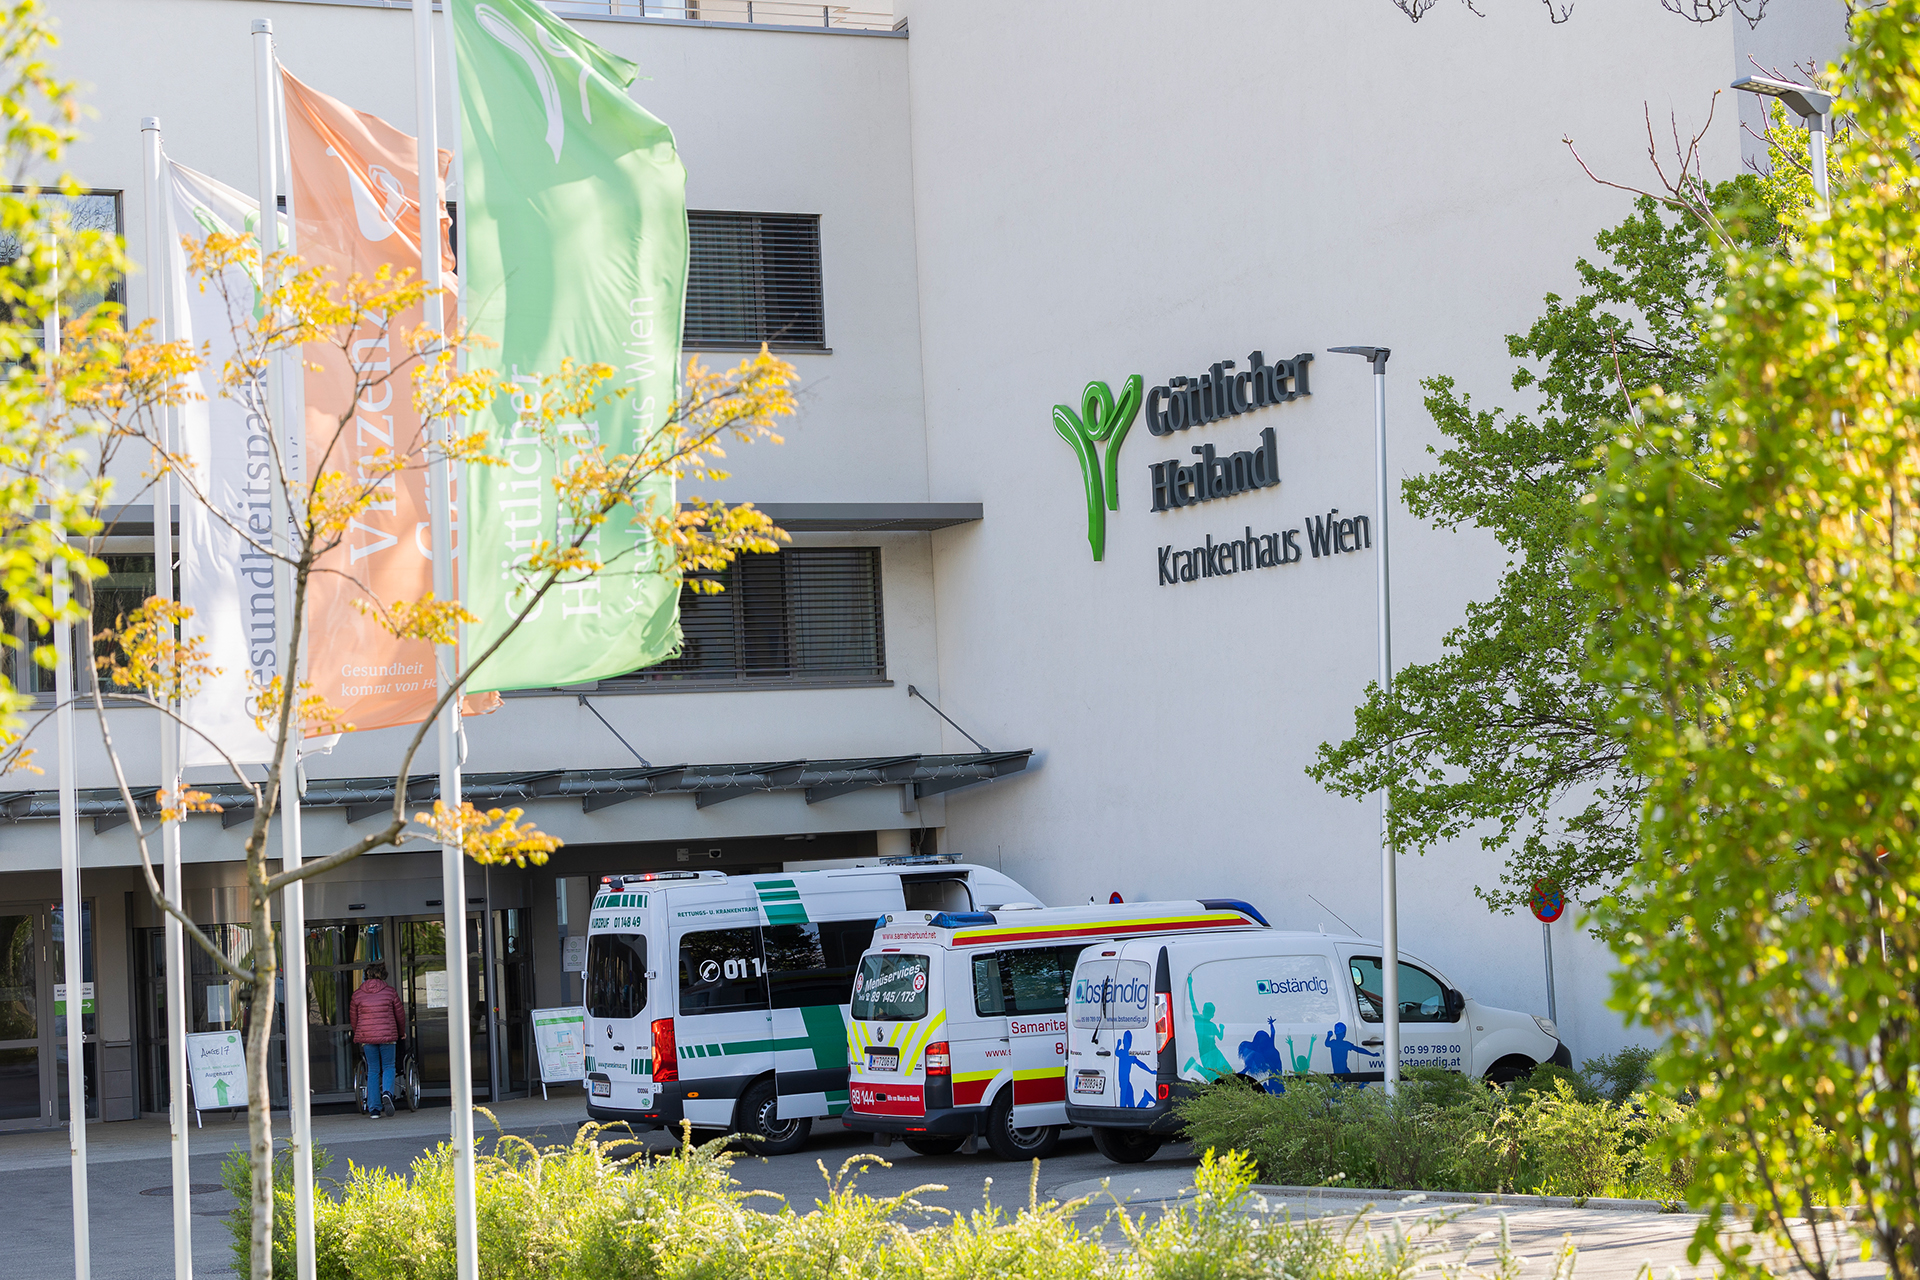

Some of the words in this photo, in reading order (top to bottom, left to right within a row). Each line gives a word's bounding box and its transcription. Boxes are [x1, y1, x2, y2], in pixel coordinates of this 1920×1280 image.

[622, 295, 655, 384] Wien
[1145, 350, 1315, 437] Göttlicher
[1148, 426, 1282, 513] Heiland
[498, 363, 544, 623] Göttlicher
[1158, 525, 1302, 586] Krankenhaus
[1305, 508, 1372, 558] Wien
[341, 661, 424, 677] Gesundheit
[341, 682, 392, 696] kommt
[395, 681, 419, 692] von
[715, 906, 759, 915] KRANKENTRANS
[632, 916, 641, 928] 49
[865, 964, 921, 992] Menüservices
[1270, 976, 1329, 994] bständig
[870, 991, 880, 1002] 89
[1011, 1018, 1067, 1034] Samarite
[1403, 1045, 1416, 1055] 05
[1417, 1045, 1429, 1054] 99
[1431, 1045, 1447, 1054] 789
[1449, 1044, 1461, 1053] 00
[851, 1089, 861, 1105] 89
[861, 1090, 875, 1106] 144
